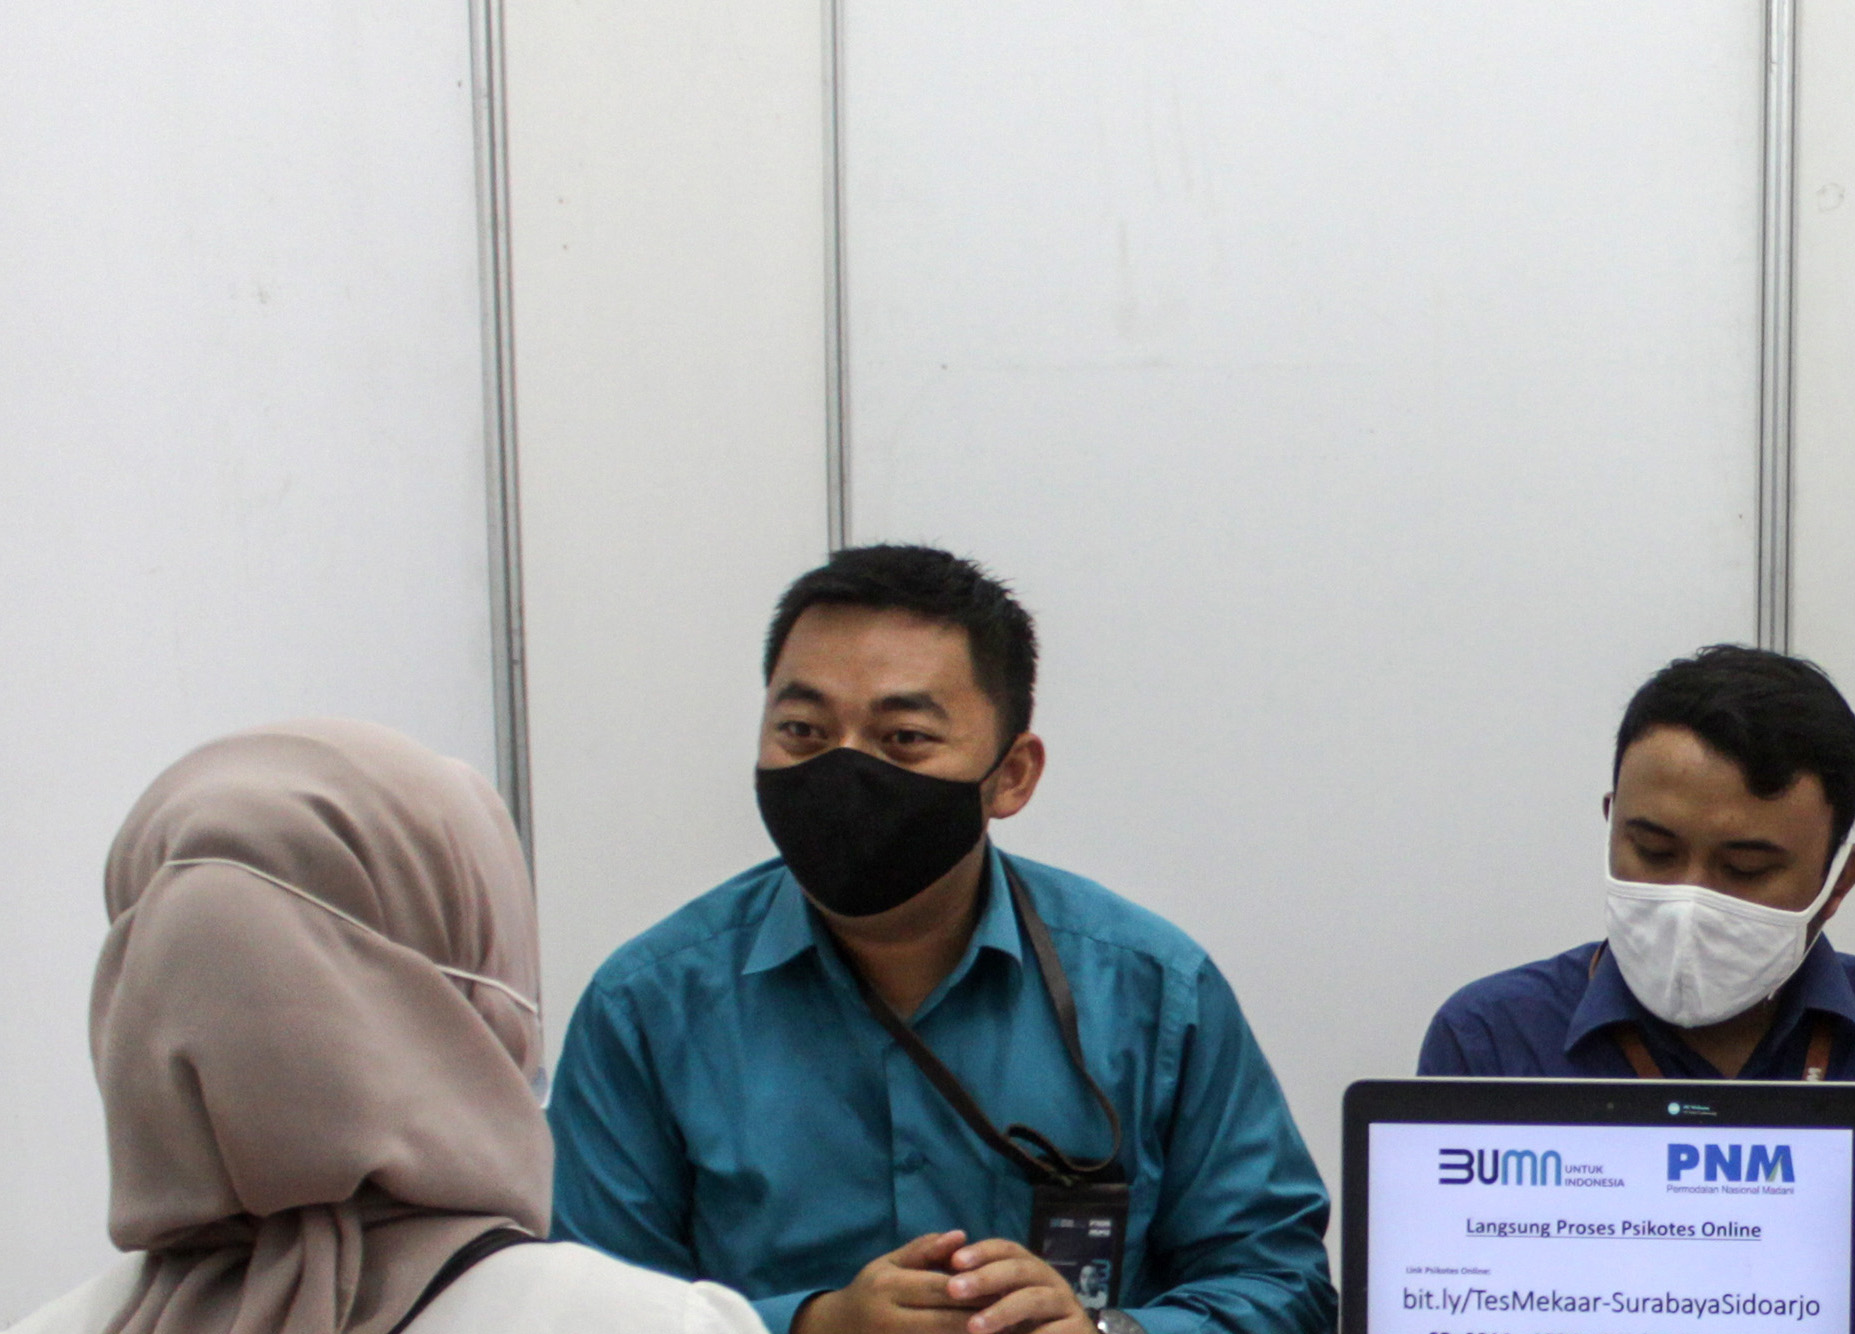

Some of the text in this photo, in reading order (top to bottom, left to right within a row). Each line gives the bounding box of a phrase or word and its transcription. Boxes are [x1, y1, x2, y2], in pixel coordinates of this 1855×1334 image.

[1565, 1165, 1602, 1174] UNTUK
[1667, 1143, 1795, 1182] PNM
[1565, 1178, 1624, 1187] INDONESIA
[1666, 1184, 1794, 1195] Permodalan Nasional Madani
[1467, 1219, 1761, 1238] Langsung Proses Psikotes Online
[1404, 1288, 1820, 1320] bit.ly/TesMekaar-SurabayaSidoarjo
